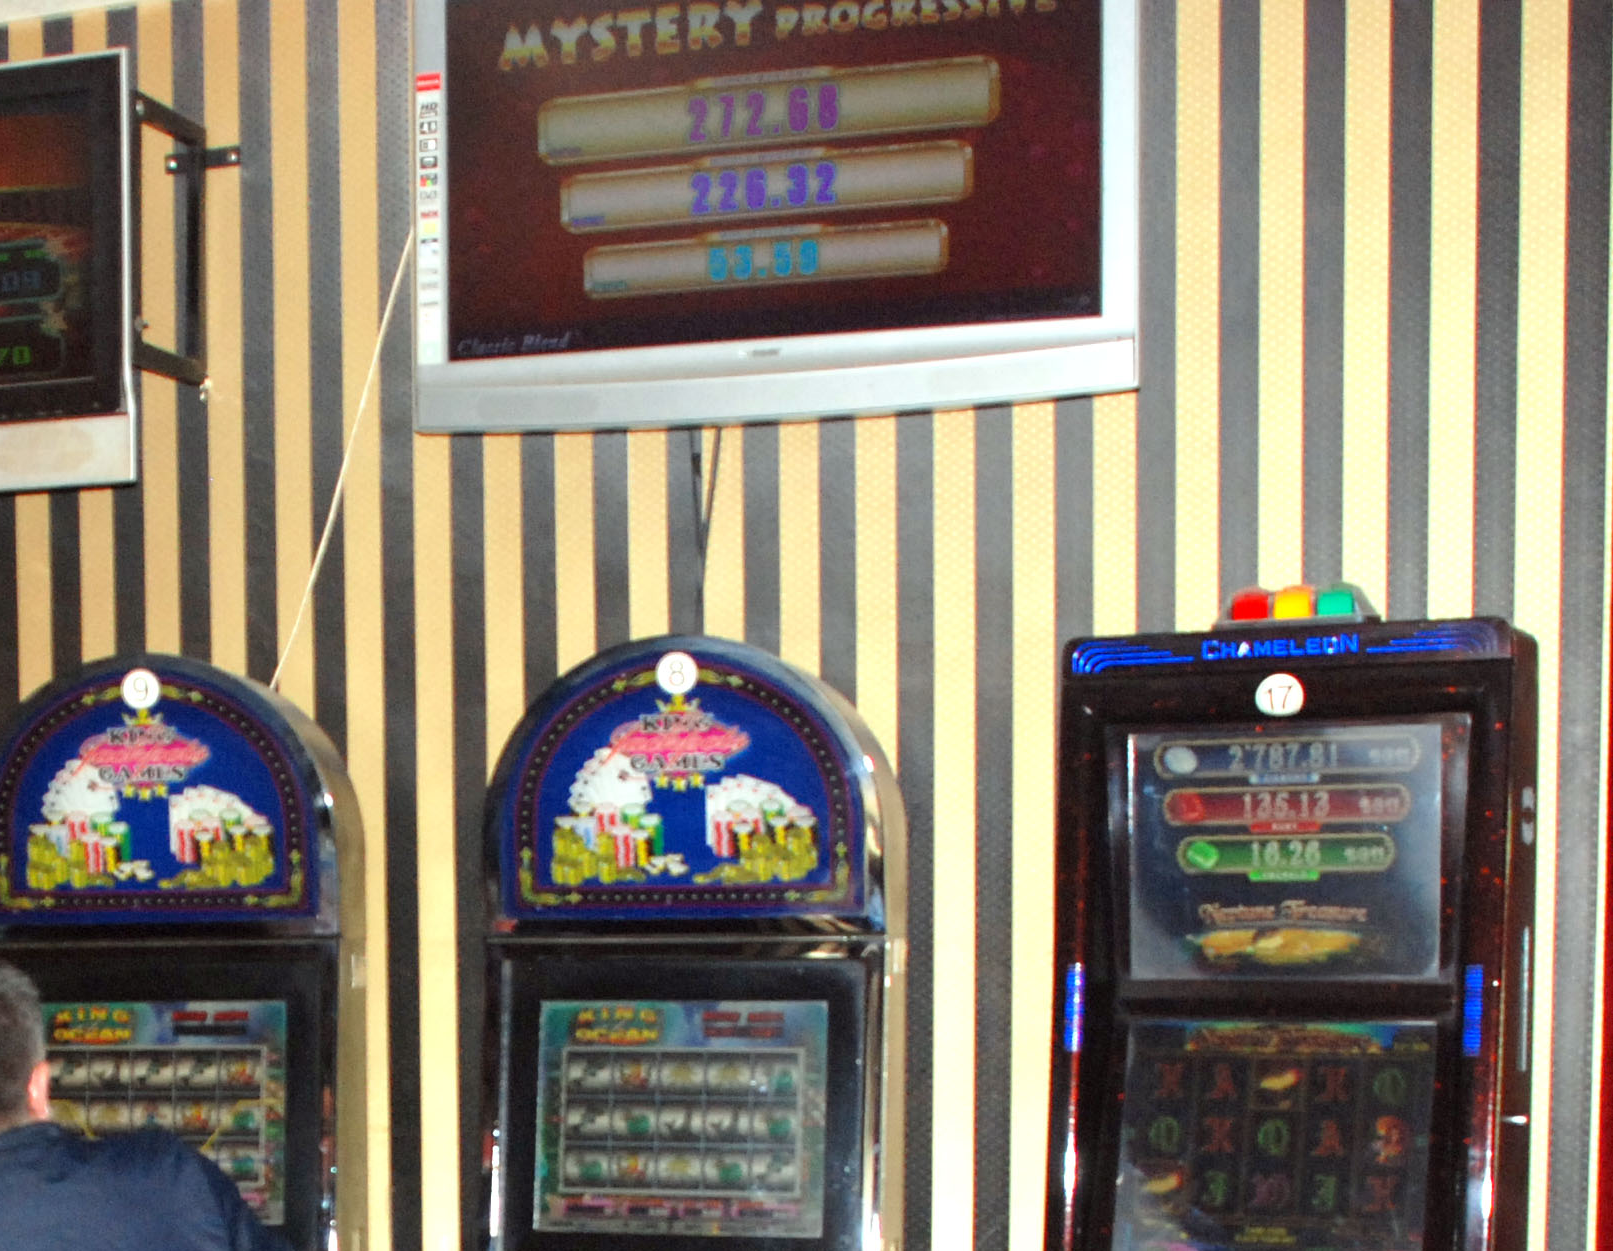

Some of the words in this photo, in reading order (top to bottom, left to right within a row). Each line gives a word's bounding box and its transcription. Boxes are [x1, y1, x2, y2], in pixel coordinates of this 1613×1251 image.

[498, 0, 763, 71] MYSTERY
[690, 160, 838, 215] 226.32
[1201, 633, 1360, 660] CHAMELEON
[668, 660, 685, 686] 8
[133, 677, 149, 702] 9
[1264, 685, 1293, 711] 17
